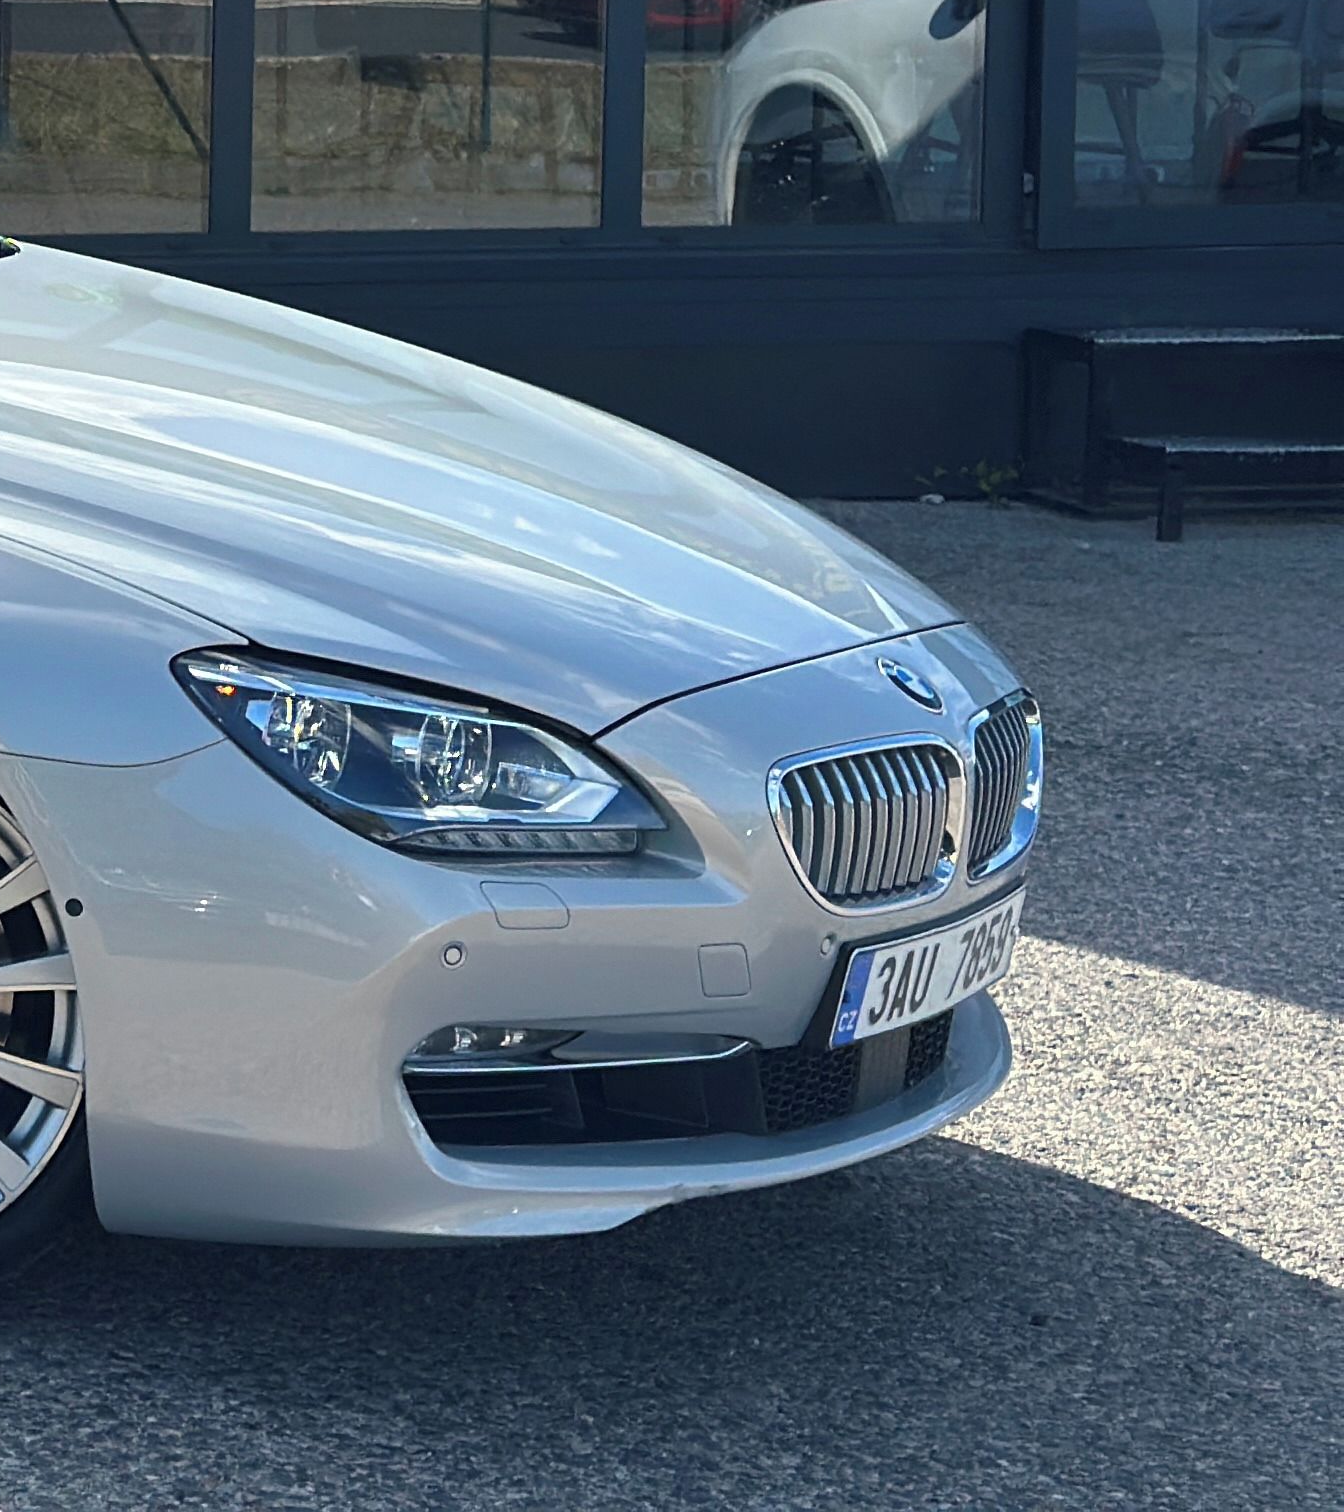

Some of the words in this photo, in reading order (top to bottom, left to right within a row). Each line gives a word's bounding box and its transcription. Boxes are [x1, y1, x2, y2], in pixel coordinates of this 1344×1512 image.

[868, 942, 941, 1025] 3AU
[946, 905, 1014, 1000] 7859
[837, 1009, 859, 1033] CZ
